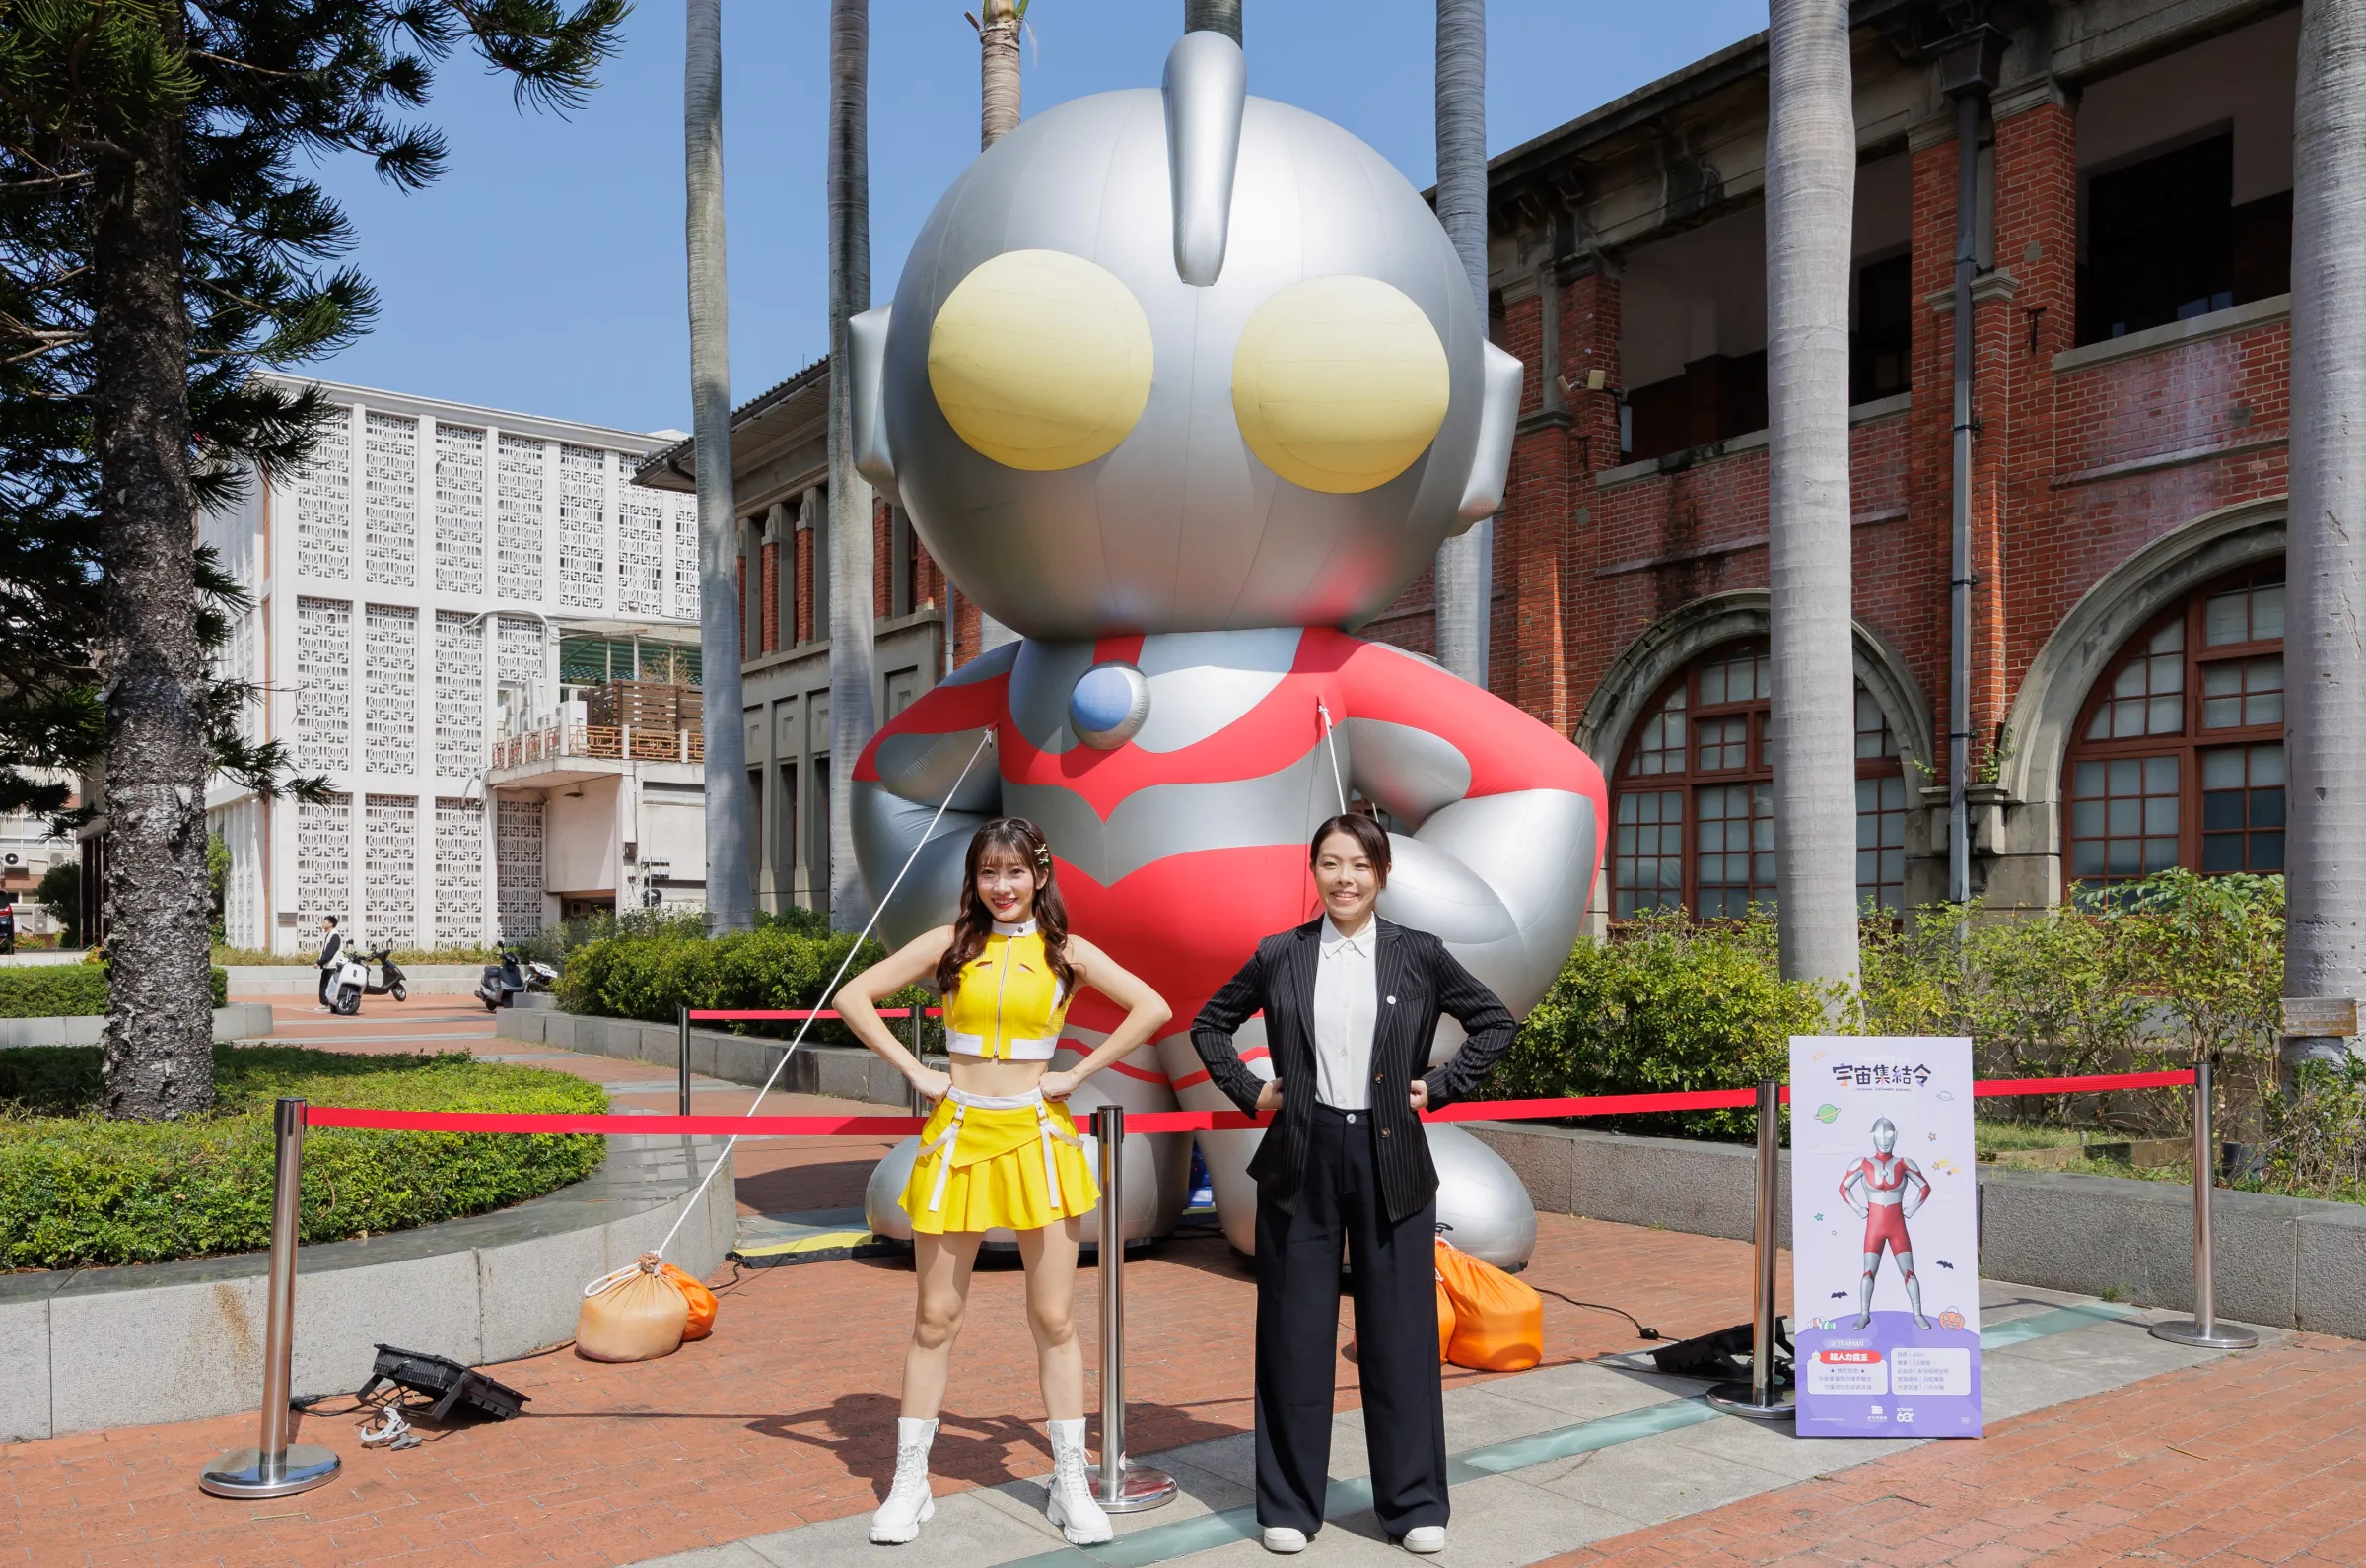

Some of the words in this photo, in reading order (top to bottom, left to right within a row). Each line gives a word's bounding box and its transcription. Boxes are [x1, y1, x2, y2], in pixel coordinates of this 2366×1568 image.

[1832, 1063, 1932, 1088] 宇宙集結令
